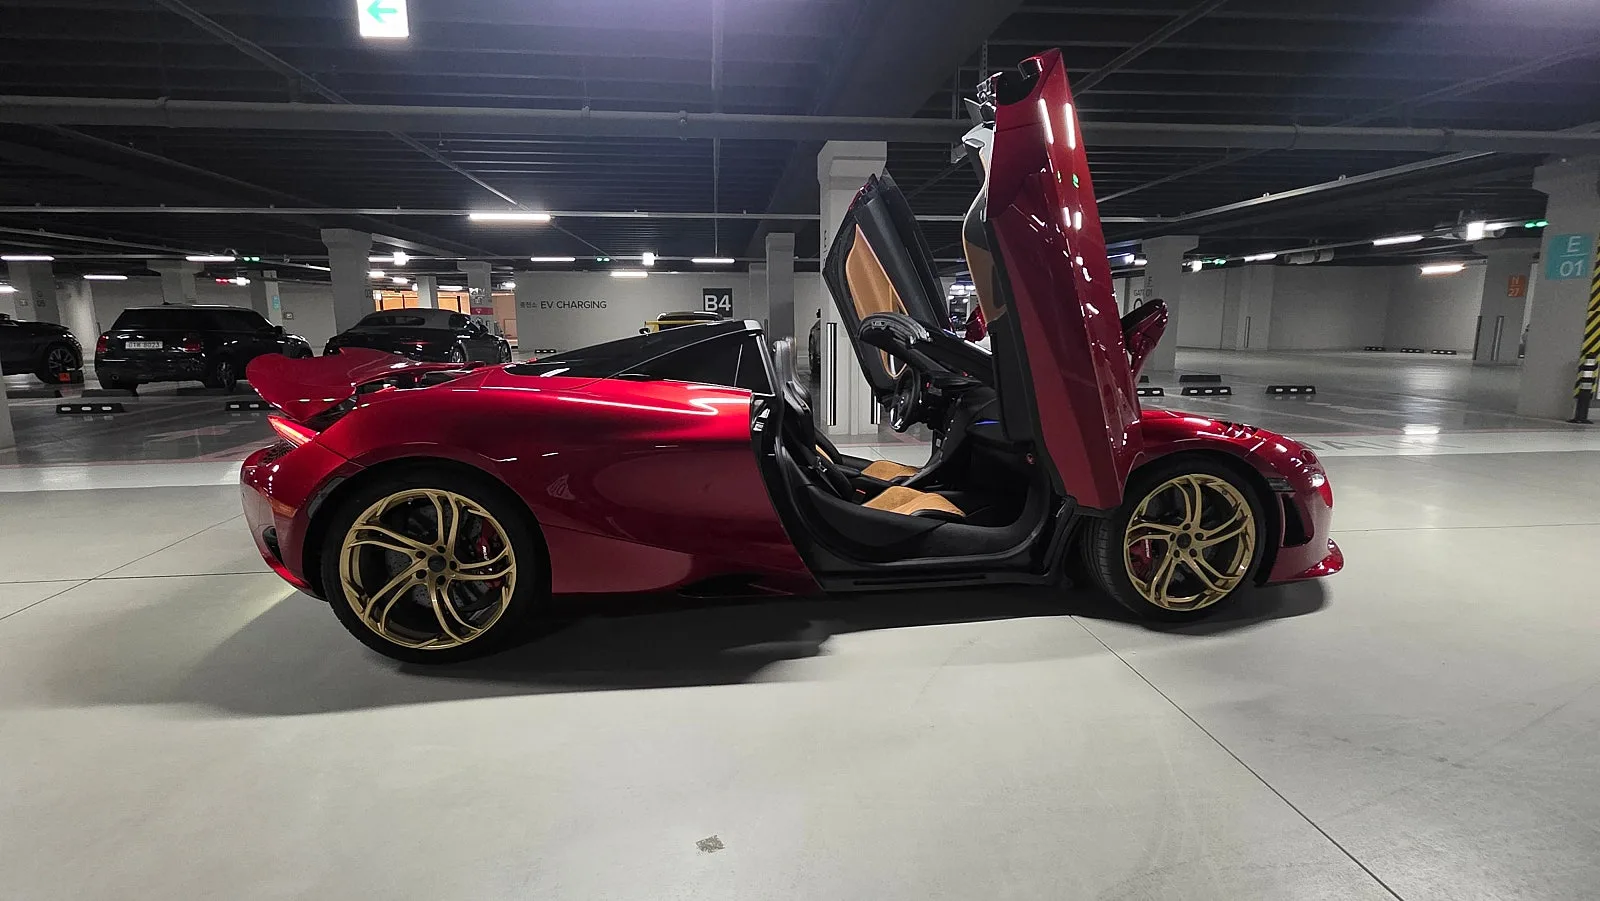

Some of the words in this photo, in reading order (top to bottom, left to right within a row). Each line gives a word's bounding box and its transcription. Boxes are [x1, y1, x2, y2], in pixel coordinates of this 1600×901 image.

[1566, 236, 1582, 253] E
[1560, 260, 1584, 277] 01
[540, 300, 554, 309] EV
[556, 300, 607, 309] CHARGING
[704, 294, 732, 312] B4
